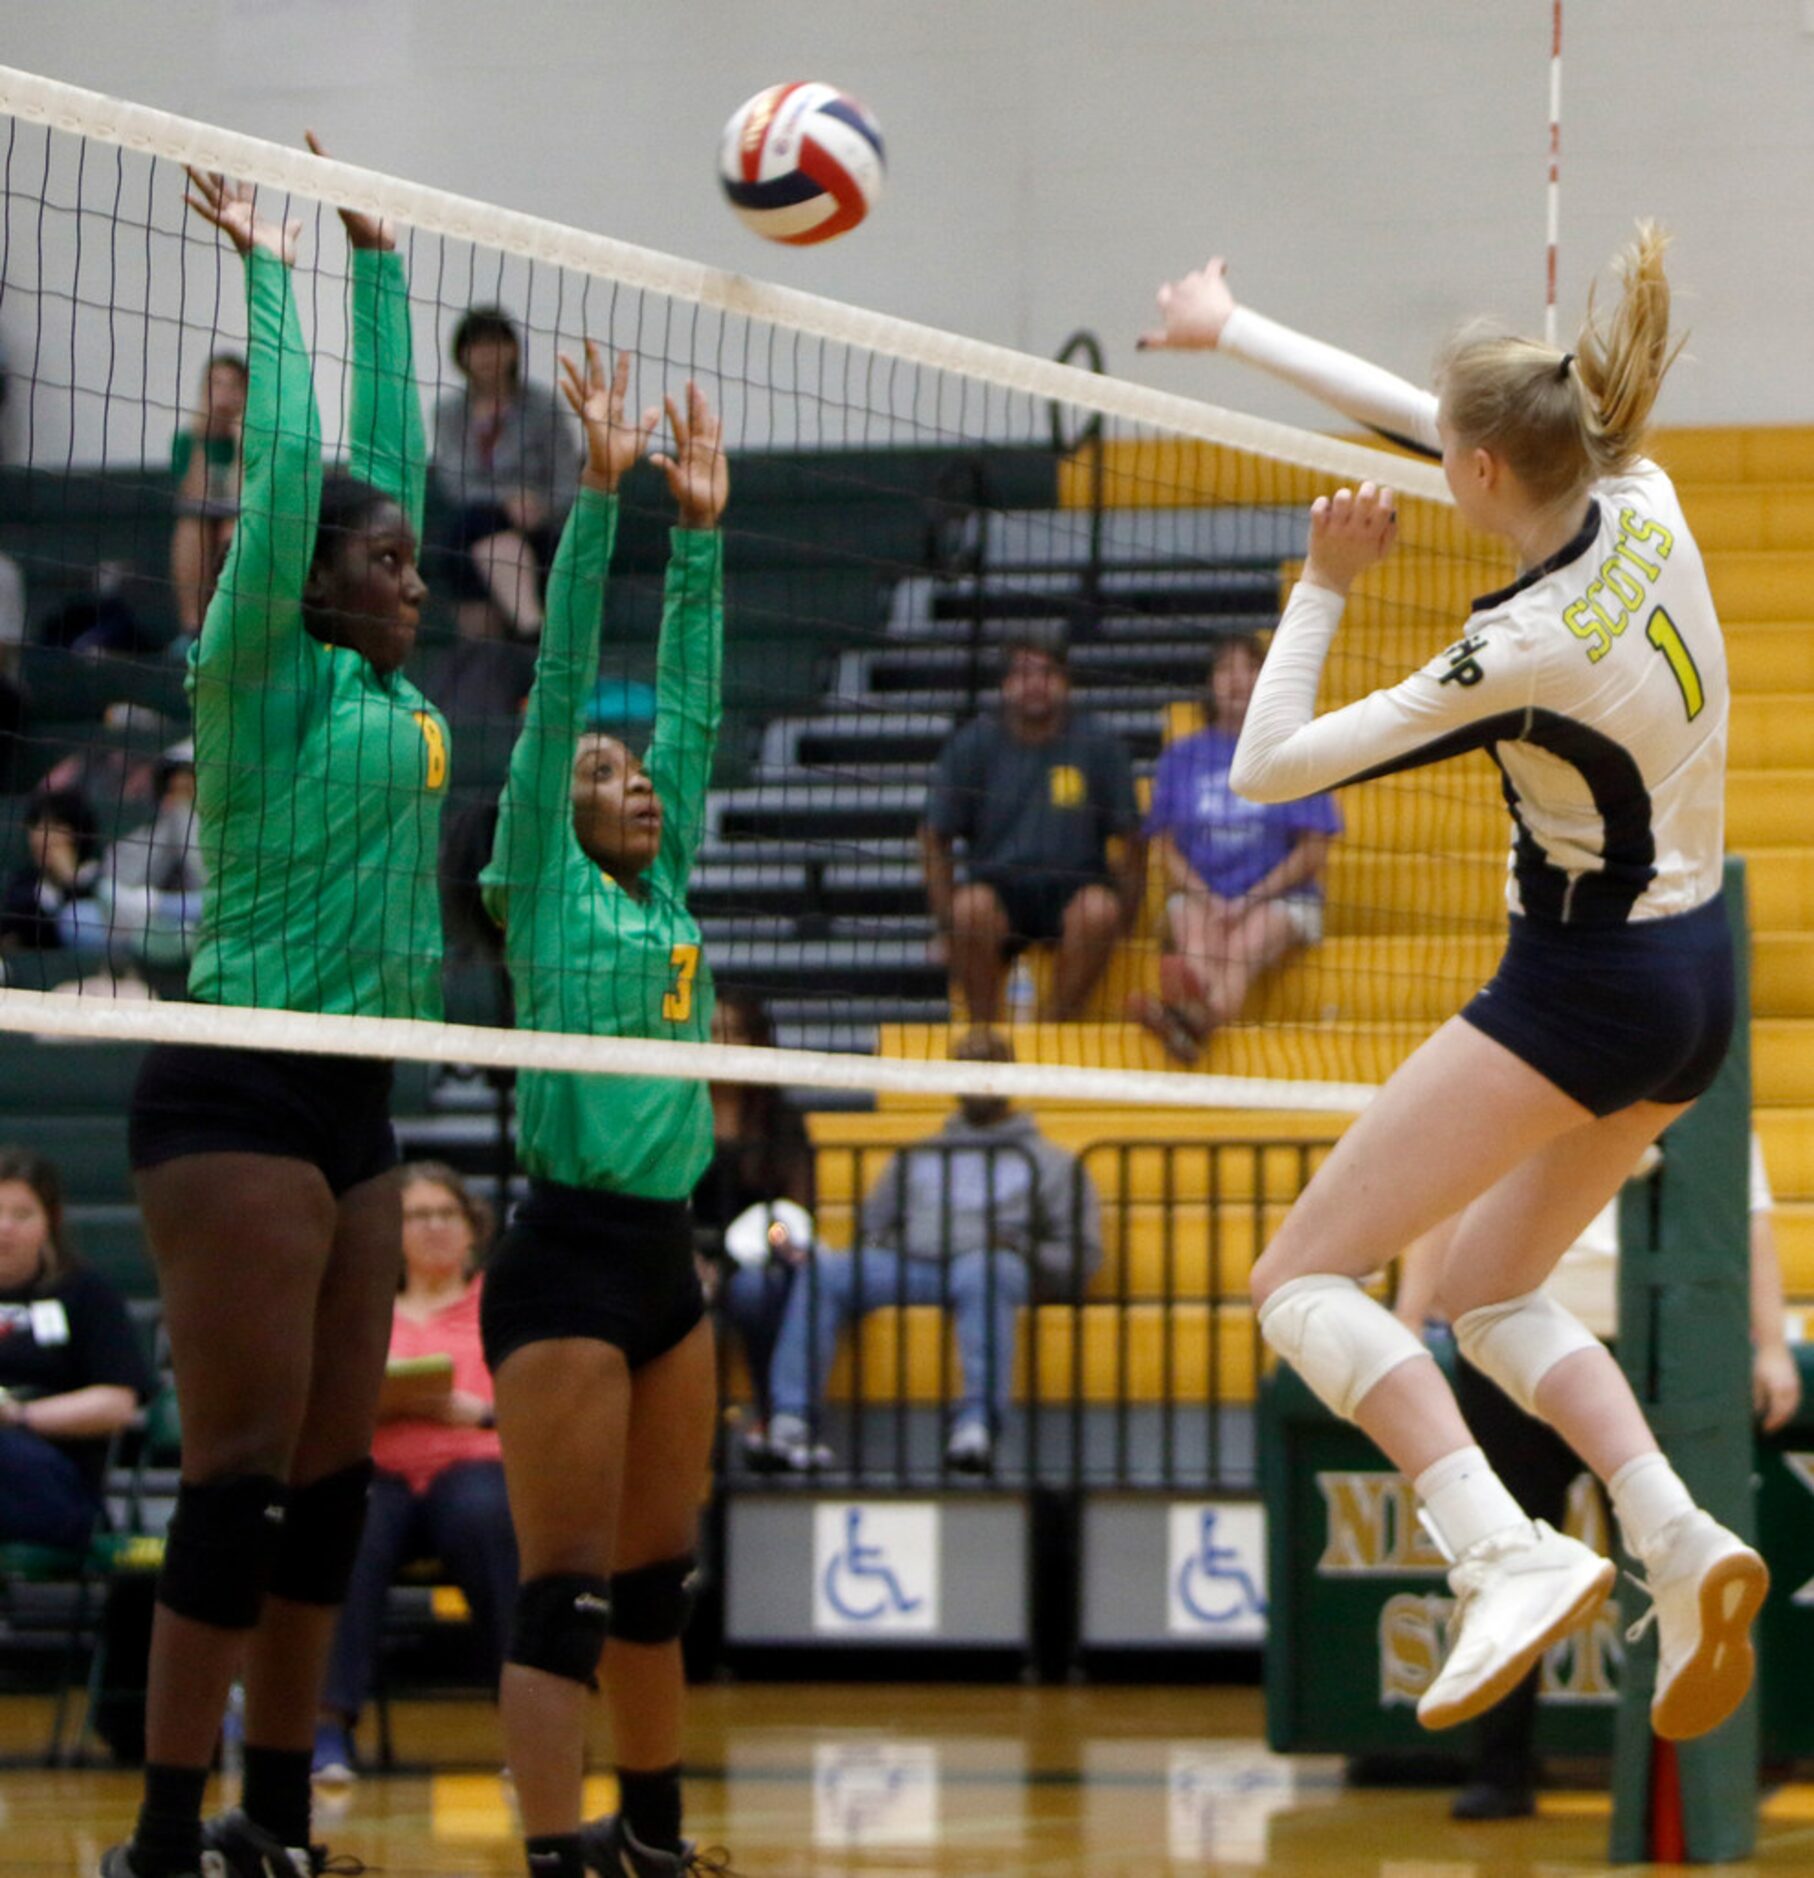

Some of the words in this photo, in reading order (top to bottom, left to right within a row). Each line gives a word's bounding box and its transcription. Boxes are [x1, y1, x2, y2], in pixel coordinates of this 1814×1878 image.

[1563, 507, 1674, 664] SCOTS
[1645, 604, 1704, 723] 1
[661, 943, 701, 1024] 3
